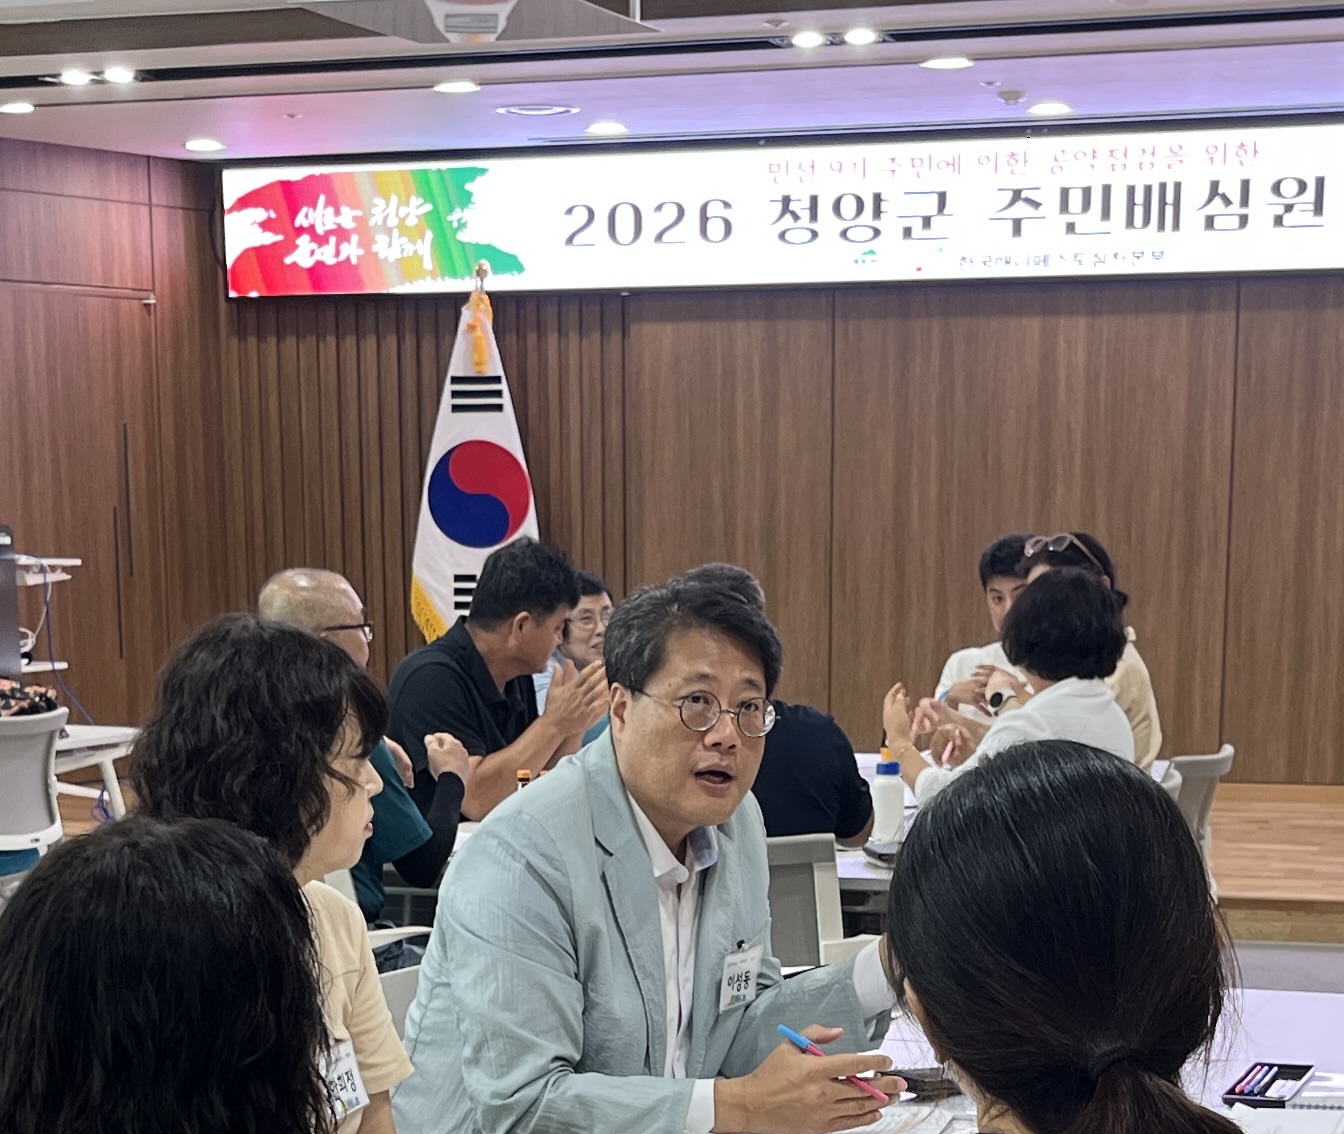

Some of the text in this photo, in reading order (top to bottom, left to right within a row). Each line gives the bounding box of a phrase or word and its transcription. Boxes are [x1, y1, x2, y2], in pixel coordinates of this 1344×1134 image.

[563, 198, 734, 247] 2026
[769, 190, 954, 246] 청양군
[988, 175, 1326, 239] 주민배심원
